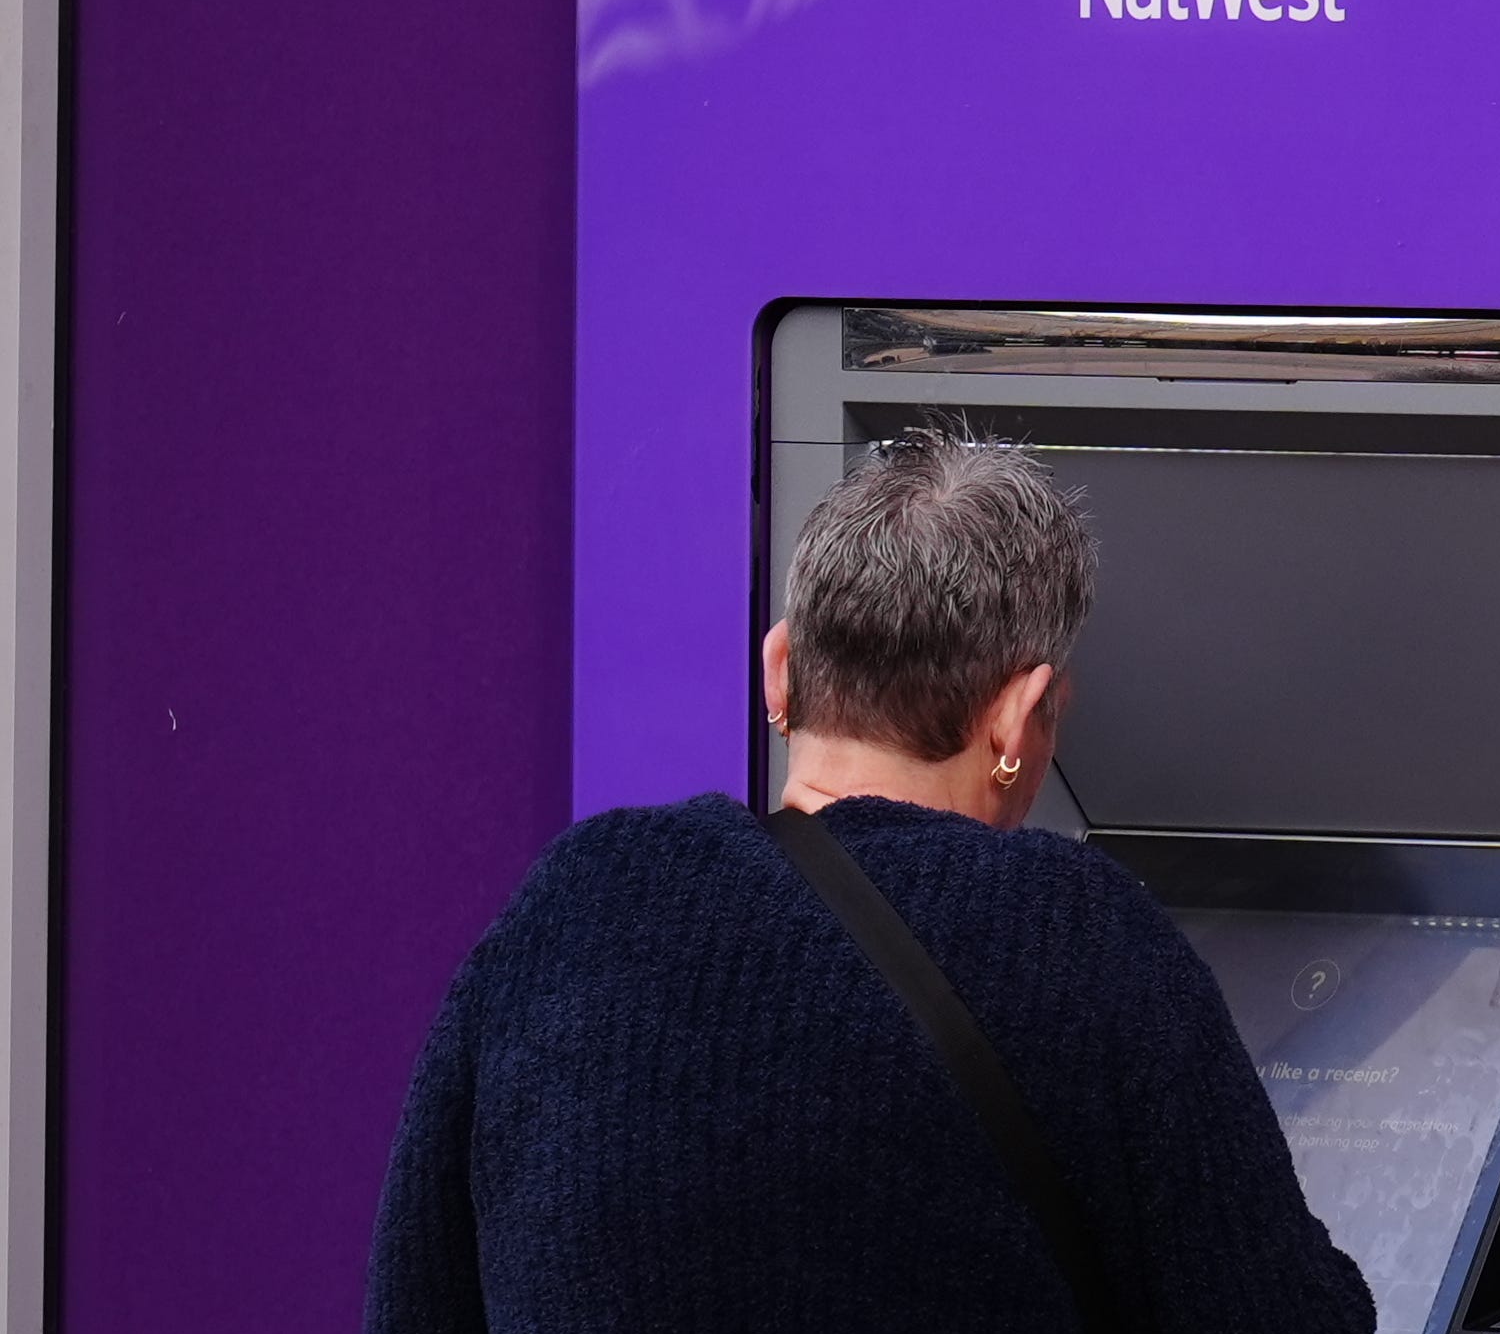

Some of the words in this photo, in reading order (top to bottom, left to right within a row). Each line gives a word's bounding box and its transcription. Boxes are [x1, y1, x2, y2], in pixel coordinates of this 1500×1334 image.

[1270, 1062, 1303, 1080] like
[1307, 1069, 1320, 1081] a
[1324, 1066, 1400, 1087] receipt?
[1354, 1139, 1379, 1153] app
